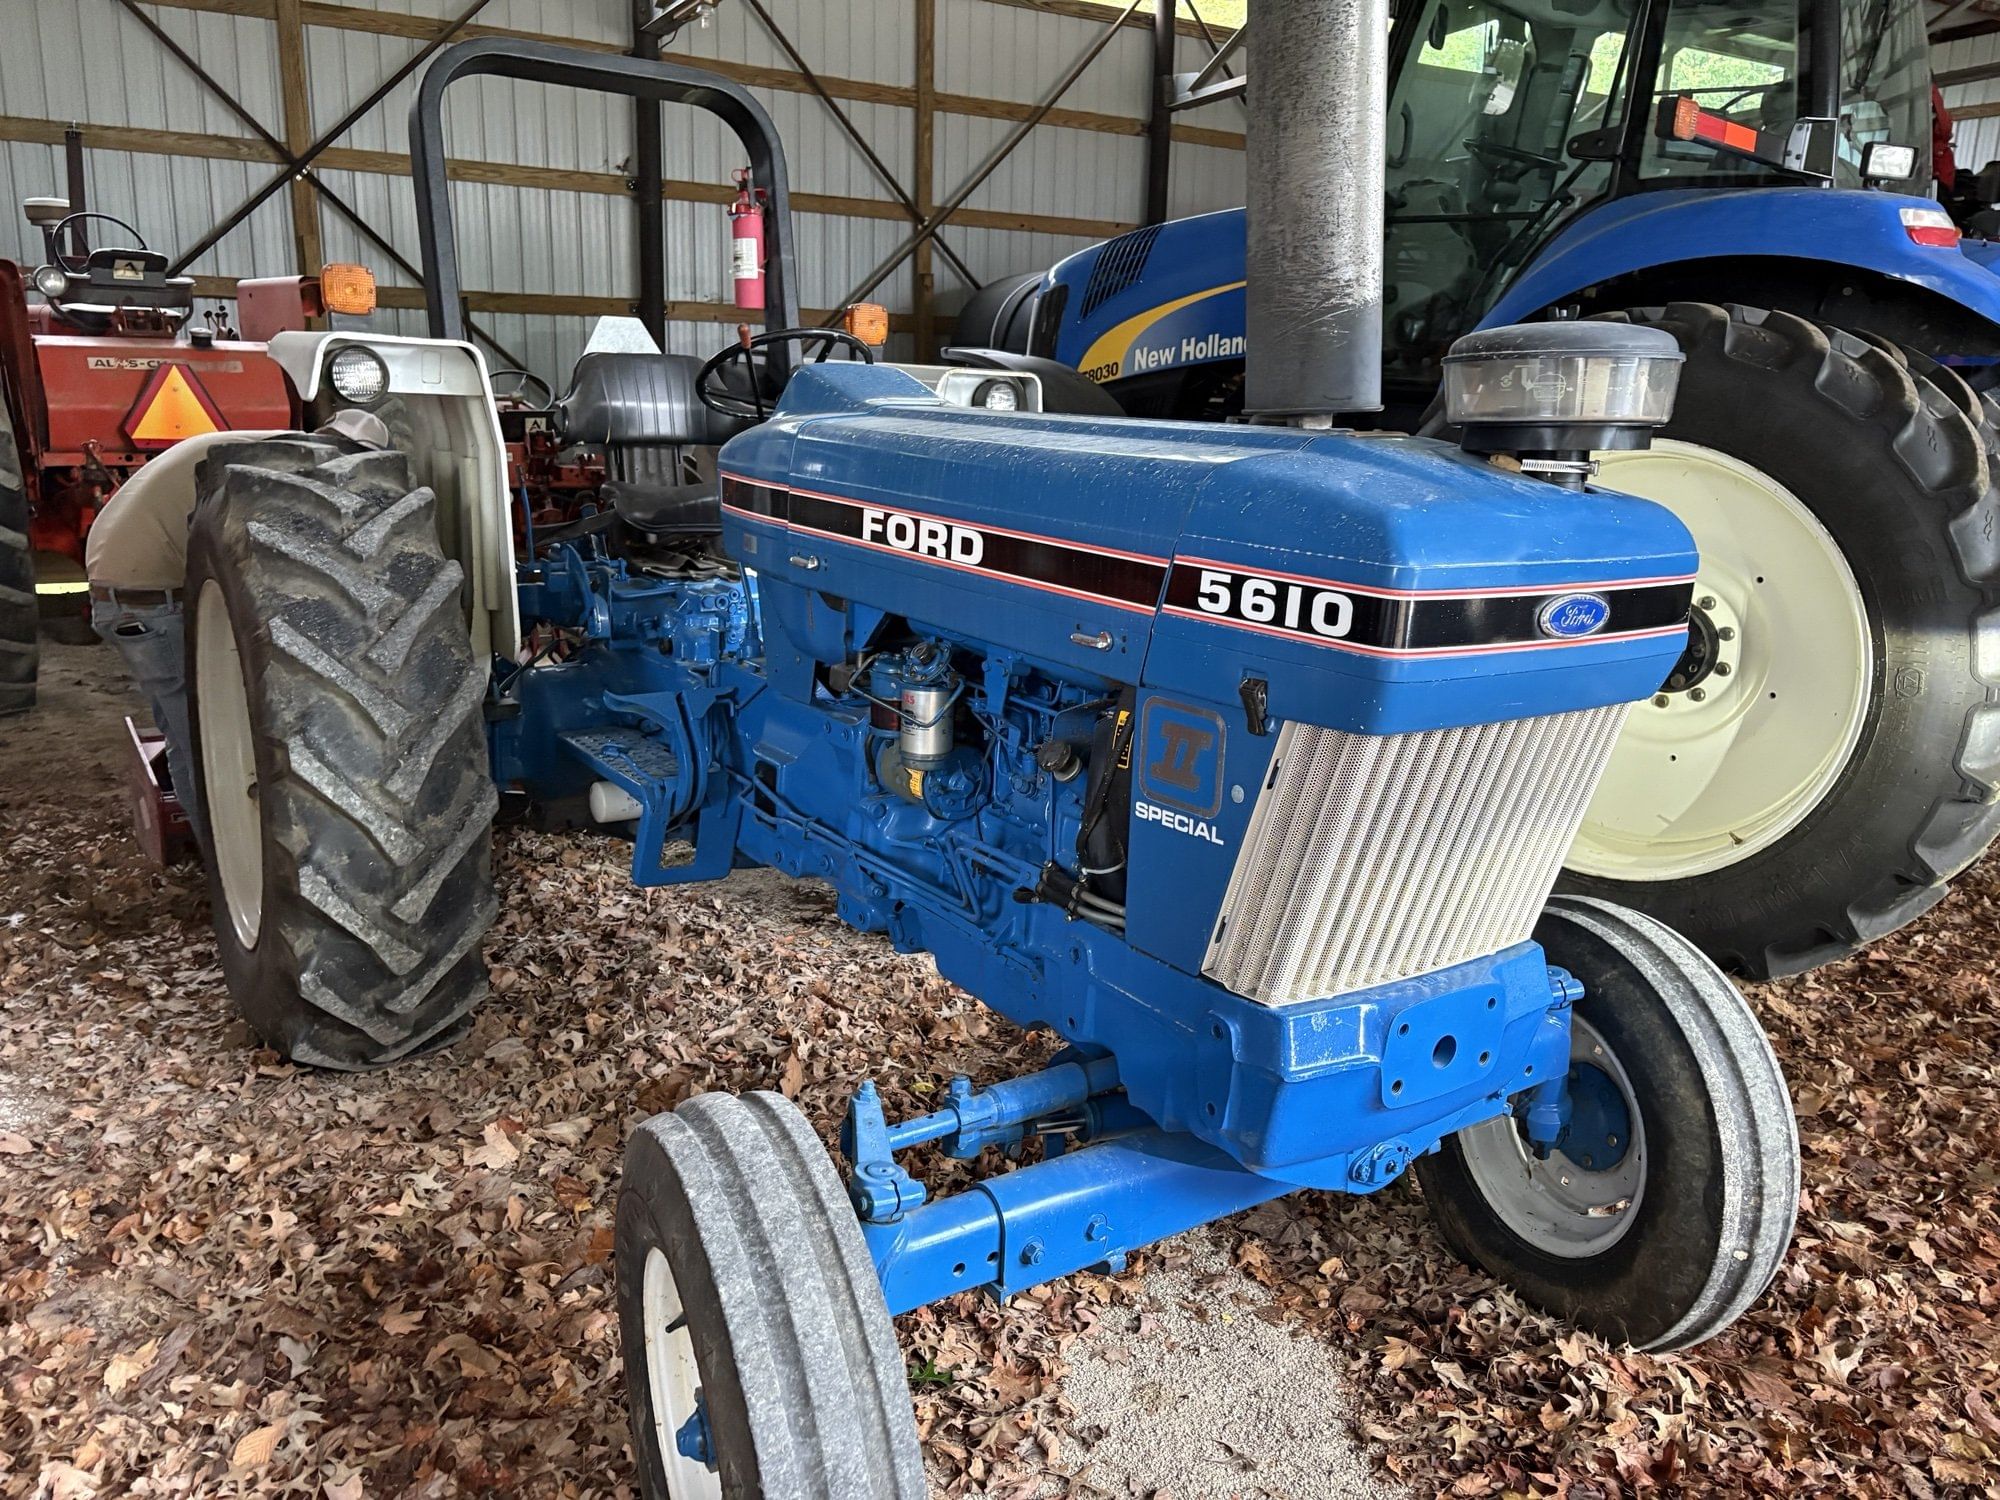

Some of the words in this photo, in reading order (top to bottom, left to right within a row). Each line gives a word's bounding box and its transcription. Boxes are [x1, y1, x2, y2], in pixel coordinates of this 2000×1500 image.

[1082, 362, 1119, 384] 8030
[1134, 347, 1177, 371] New
[862, 508, 984, 566] FORD
[1197, 570, 1354, 638] 5610
[1560, 604, 1595, 627] Ford
[1134, 801, 1225, 845] SPECIAL
